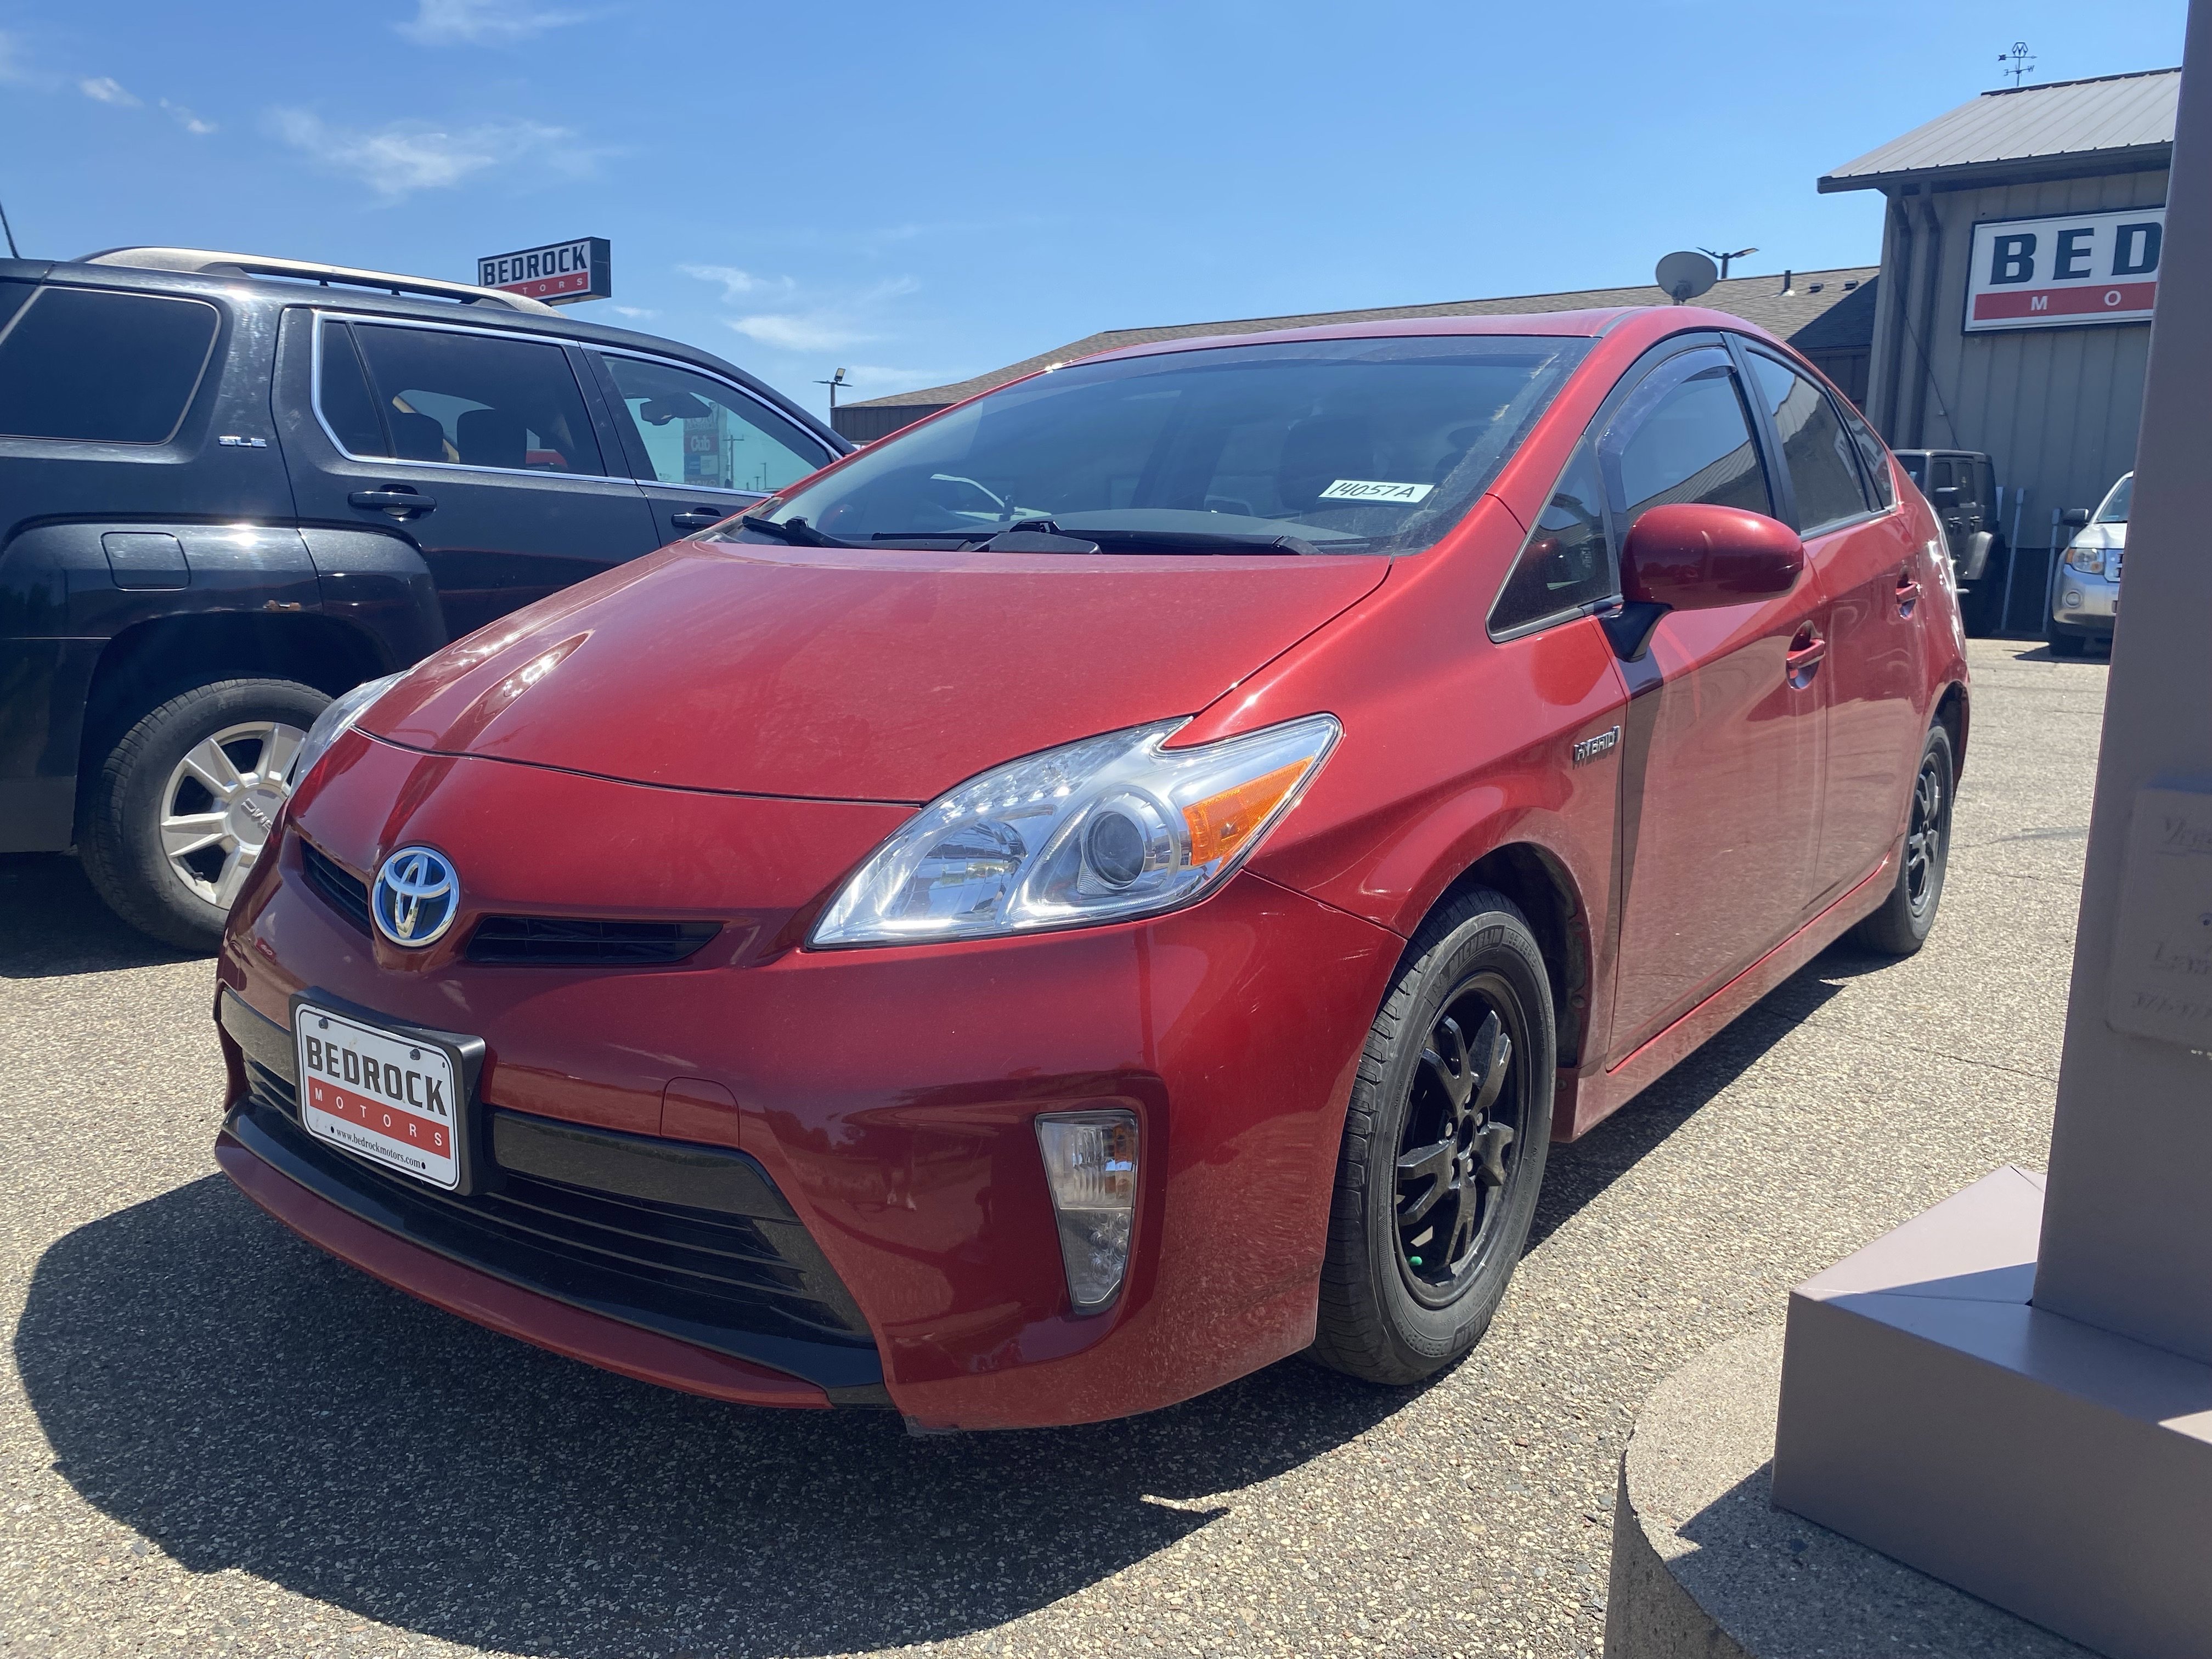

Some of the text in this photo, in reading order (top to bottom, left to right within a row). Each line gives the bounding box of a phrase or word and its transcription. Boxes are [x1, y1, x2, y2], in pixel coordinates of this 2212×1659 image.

[483, 245, 587, 286] BEDROCK
[522, 278, 583, 295] TORS
[1328, 482, 1415, 498] 14057A
[1573, 725, 1622, 761] HYBRID
[1449, 928, 1502, 978] MICHELIN
[306, 1035, 448, 1117] BEDROCK
[315, 1087, 442, 1147] MOTORS
[336, 1128, 421, 1169] www.bedrockmotors.com
